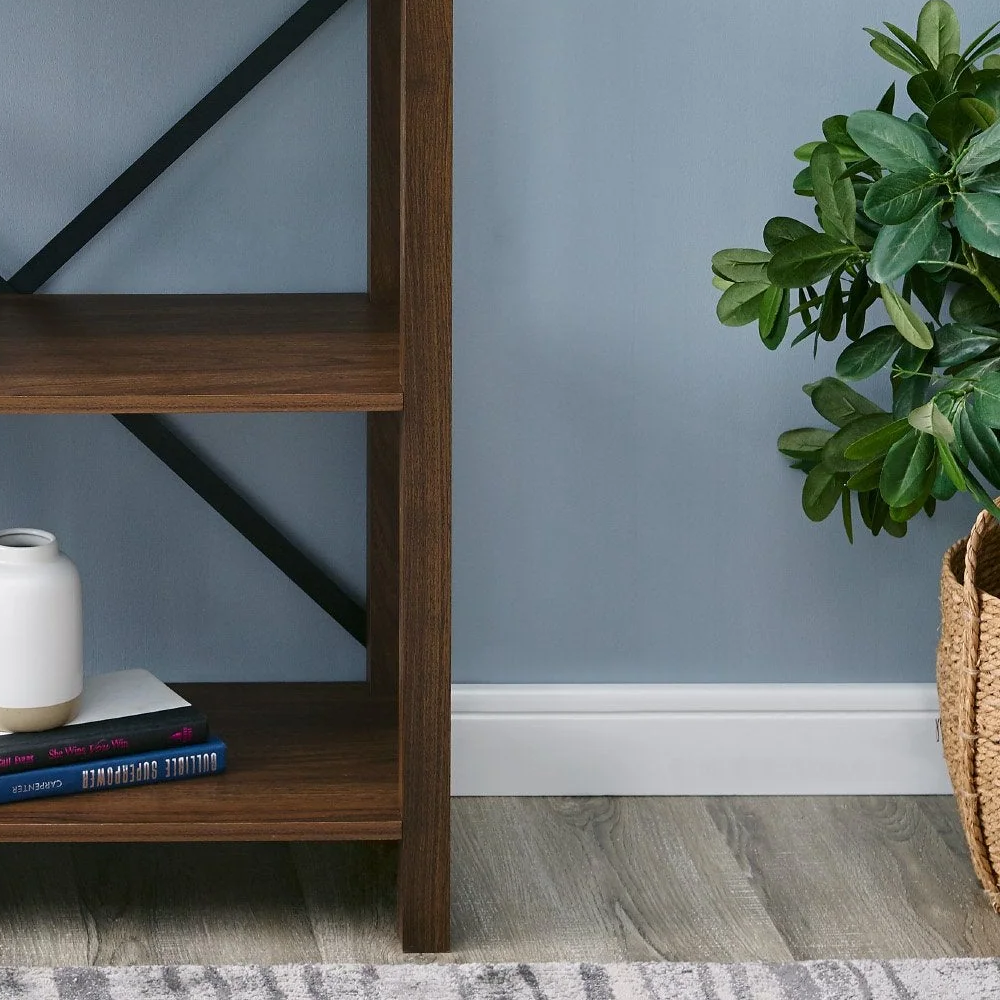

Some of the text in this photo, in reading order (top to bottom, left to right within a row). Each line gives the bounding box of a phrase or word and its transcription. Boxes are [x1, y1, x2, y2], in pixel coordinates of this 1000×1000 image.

[48, 748, 64, 759] She
[82, 760, 158, 789] SUPERPOWER
[12, 779, 63, 794] CARPENTER
